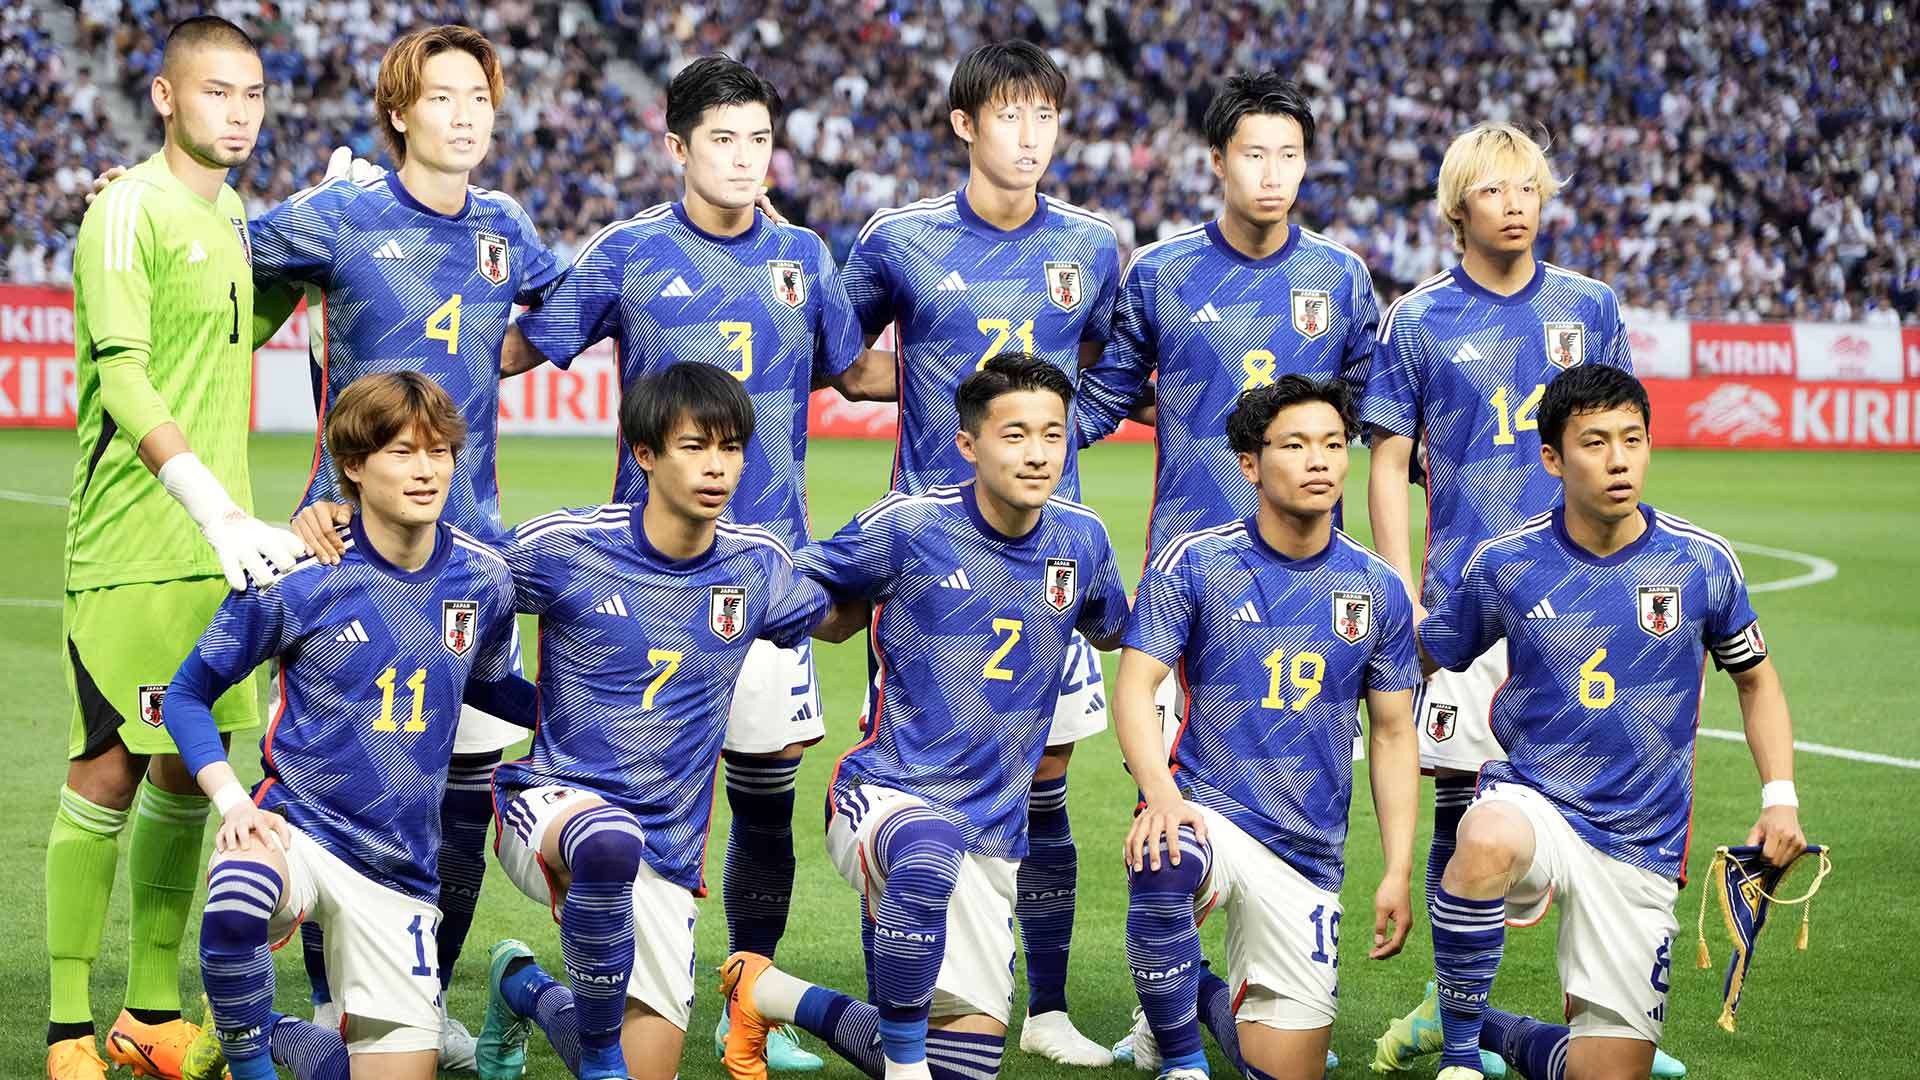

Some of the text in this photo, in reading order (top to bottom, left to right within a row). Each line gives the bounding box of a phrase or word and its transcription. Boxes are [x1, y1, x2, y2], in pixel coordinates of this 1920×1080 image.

[230, 281, 239, 344] 1
[426, 293, 462, 354] 4
[719, 321, 753, 382] 3
[976, 319, 1035, 371] 21
[1695, 339, 1792, 375] KIRIN
[1489, 383, 1546, 445] 14
[1791, 388, 1920, 444] KIRI
[720, 623, 736, 633] JFA
[1053, 595, 1067, 604] JFA
[1650, 620, 1668, 630] JFA
[452, 637, 467, 648] JFA
[983, 617, 1024, 681] 2
[1343, 626, 1360, 636] JFA
[372, 667, 429, 733] 11
[647, 648, 684, 711] 7
[1261, 648, 1326, 711] 19
[1579, 648, 1616, 710] 6
